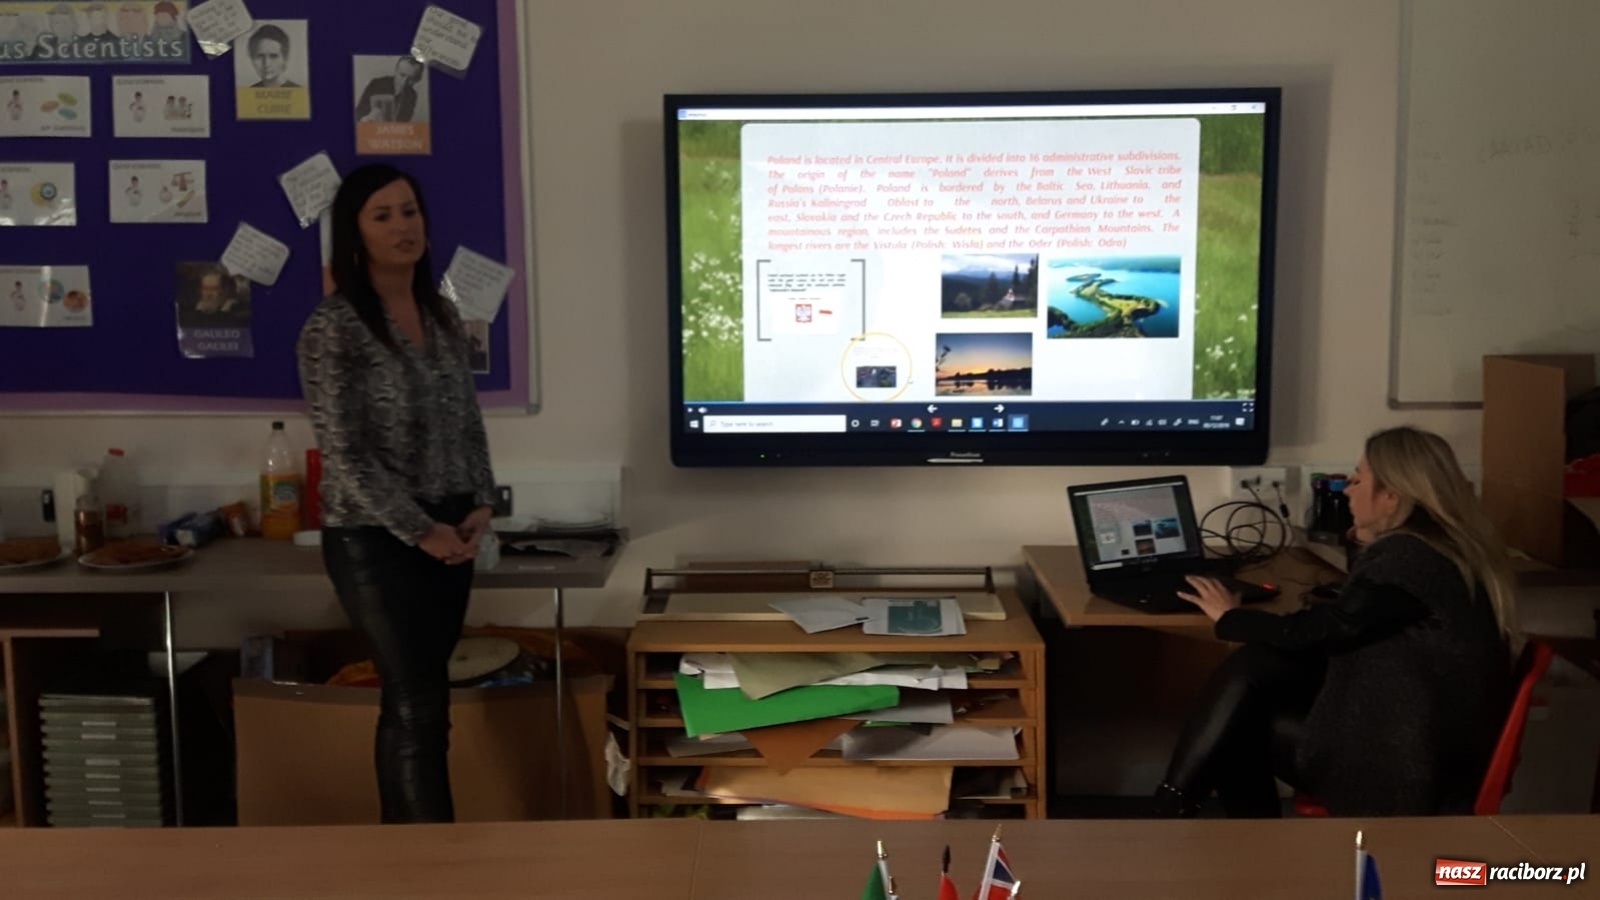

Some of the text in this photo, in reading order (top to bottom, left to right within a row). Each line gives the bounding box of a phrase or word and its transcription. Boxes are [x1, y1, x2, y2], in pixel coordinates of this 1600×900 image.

[38, 32, 184, 59] Scientists
[768, 156, 801, 164] Poland
[804, 155, 812, 164] is
[814, 155, 851, 164] located
[854, 155, 863, 164] in
[866, 154, 902, 164] Central
[956, 154, 964, 163] is
[967, 153, 1003, 163] divided
[1006, 153, 1025, 162] into
[1030, 153, 1039, 162] 16
[1043, 153, 1114, 162] administrative
[1118, 152, 1181, 161] subdivisions.
[837, 170, 848, 181] of
[861, 169, 876, 178] the
[984, 167, 1018, 176] derives
[1030, 167, 1054, 179] from
[1067, 167, 1083, 176] the
[1088, 167, 1112, 176] West
[1125, 166, 1153, 175] Slavic
[1158, 166, 1181, 175] tribe
[768, 185, 778, 195] of
[877, 184, 911, 192] Poland
[921, 184, 928, 192] is
[939, 183, 983, 192] bordered
[994, 182, 1005, 193] by
[1017, 182, 1032, 191] the
[1037, 181, 1064, 190] Baltic
[1162, 179, 1181, 189] and
[955, 197, 970, 206] the
[991, 197, 1021, 206] north,
[1026, 196, 1062, 205] Belarus
[1067, 196, 1085, 205] and
[1091, 195, 1129, 204] Ukraine
[1133, 195, 1143, 204] to
[1165, 194, 1180, 203] the
[796, 213, 837, 221] Slovakia
[841, 213, 859, 221] and
[864, 212, 879, 221] the
[884, 212, 912, 221] Czech
[916, 211, 957, 223] Republic
[963, 211, 972, 220] to
[977, 211, 992, 220] the
[1031, 210, 1050, 220] and
[1055, 209, 1098, 221] Germany
[1103, 210, 1113, 218] to
[1118, 209, 1133, 218] the
[1173, 209, 1180, 217] A
[924, 226, 940, 235] the
[945, 226, 981, 235] Sudetes
[989, 225, 1008, 234] and
[1015, 224, 1030, 233] the
[1035, 224, 1091, 235] Carpathian
[854, 241, 869, 249] the
[874, 240, 907, 250] Vistula
[987, 239, 1005, 248] and
[1009, 239, 1024, 247] the
[1029, 239, 1052, 247] Oder
